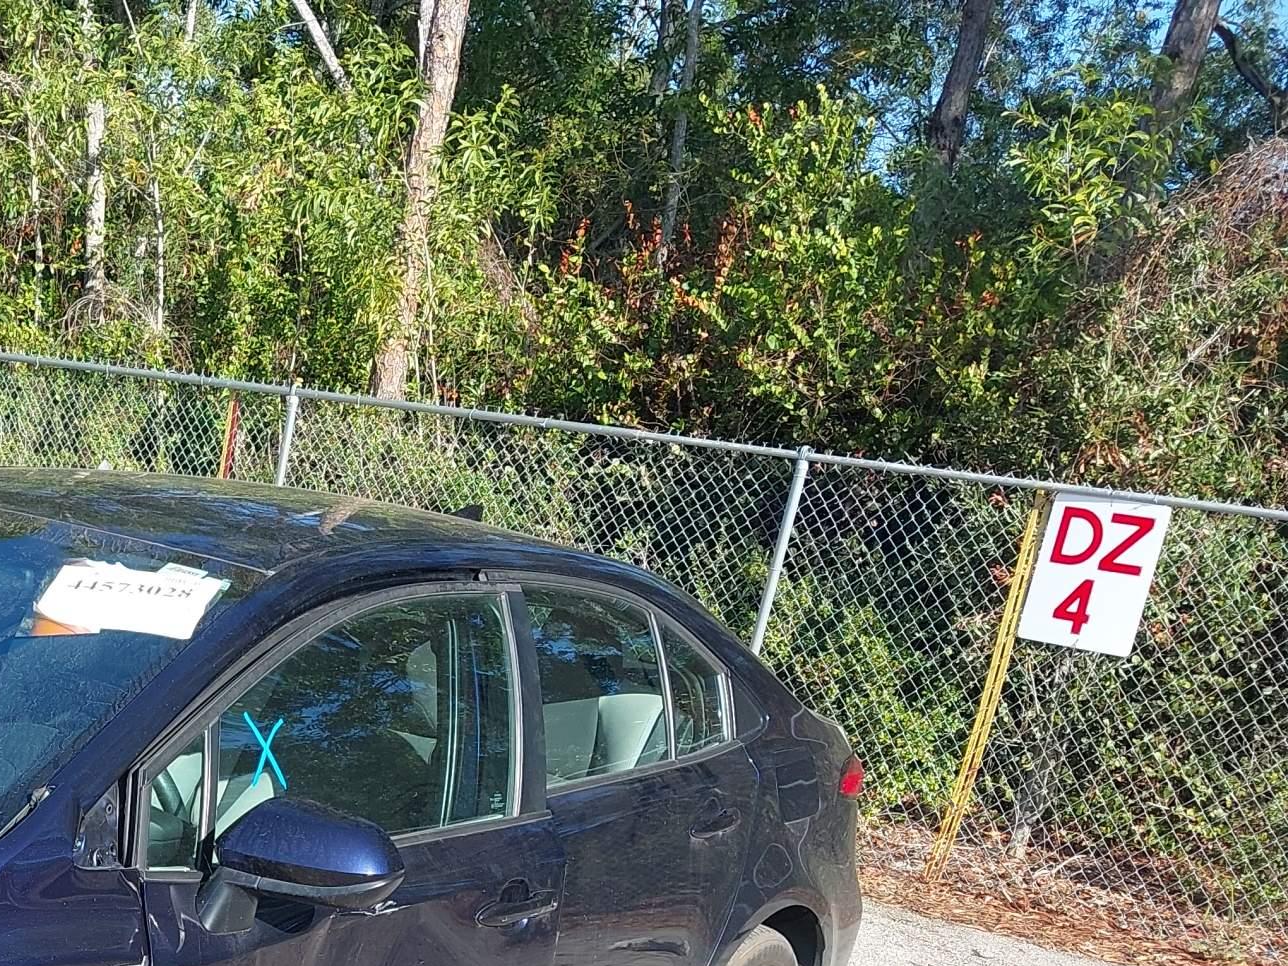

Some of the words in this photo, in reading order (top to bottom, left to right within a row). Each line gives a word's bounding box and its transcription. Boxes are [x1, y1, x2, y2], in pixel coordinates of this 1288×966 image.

[1049, 506, 1157, 577] DZ
[66, 579, 194, 599] 44573028
[1051, 578, 1096, 636] 4
